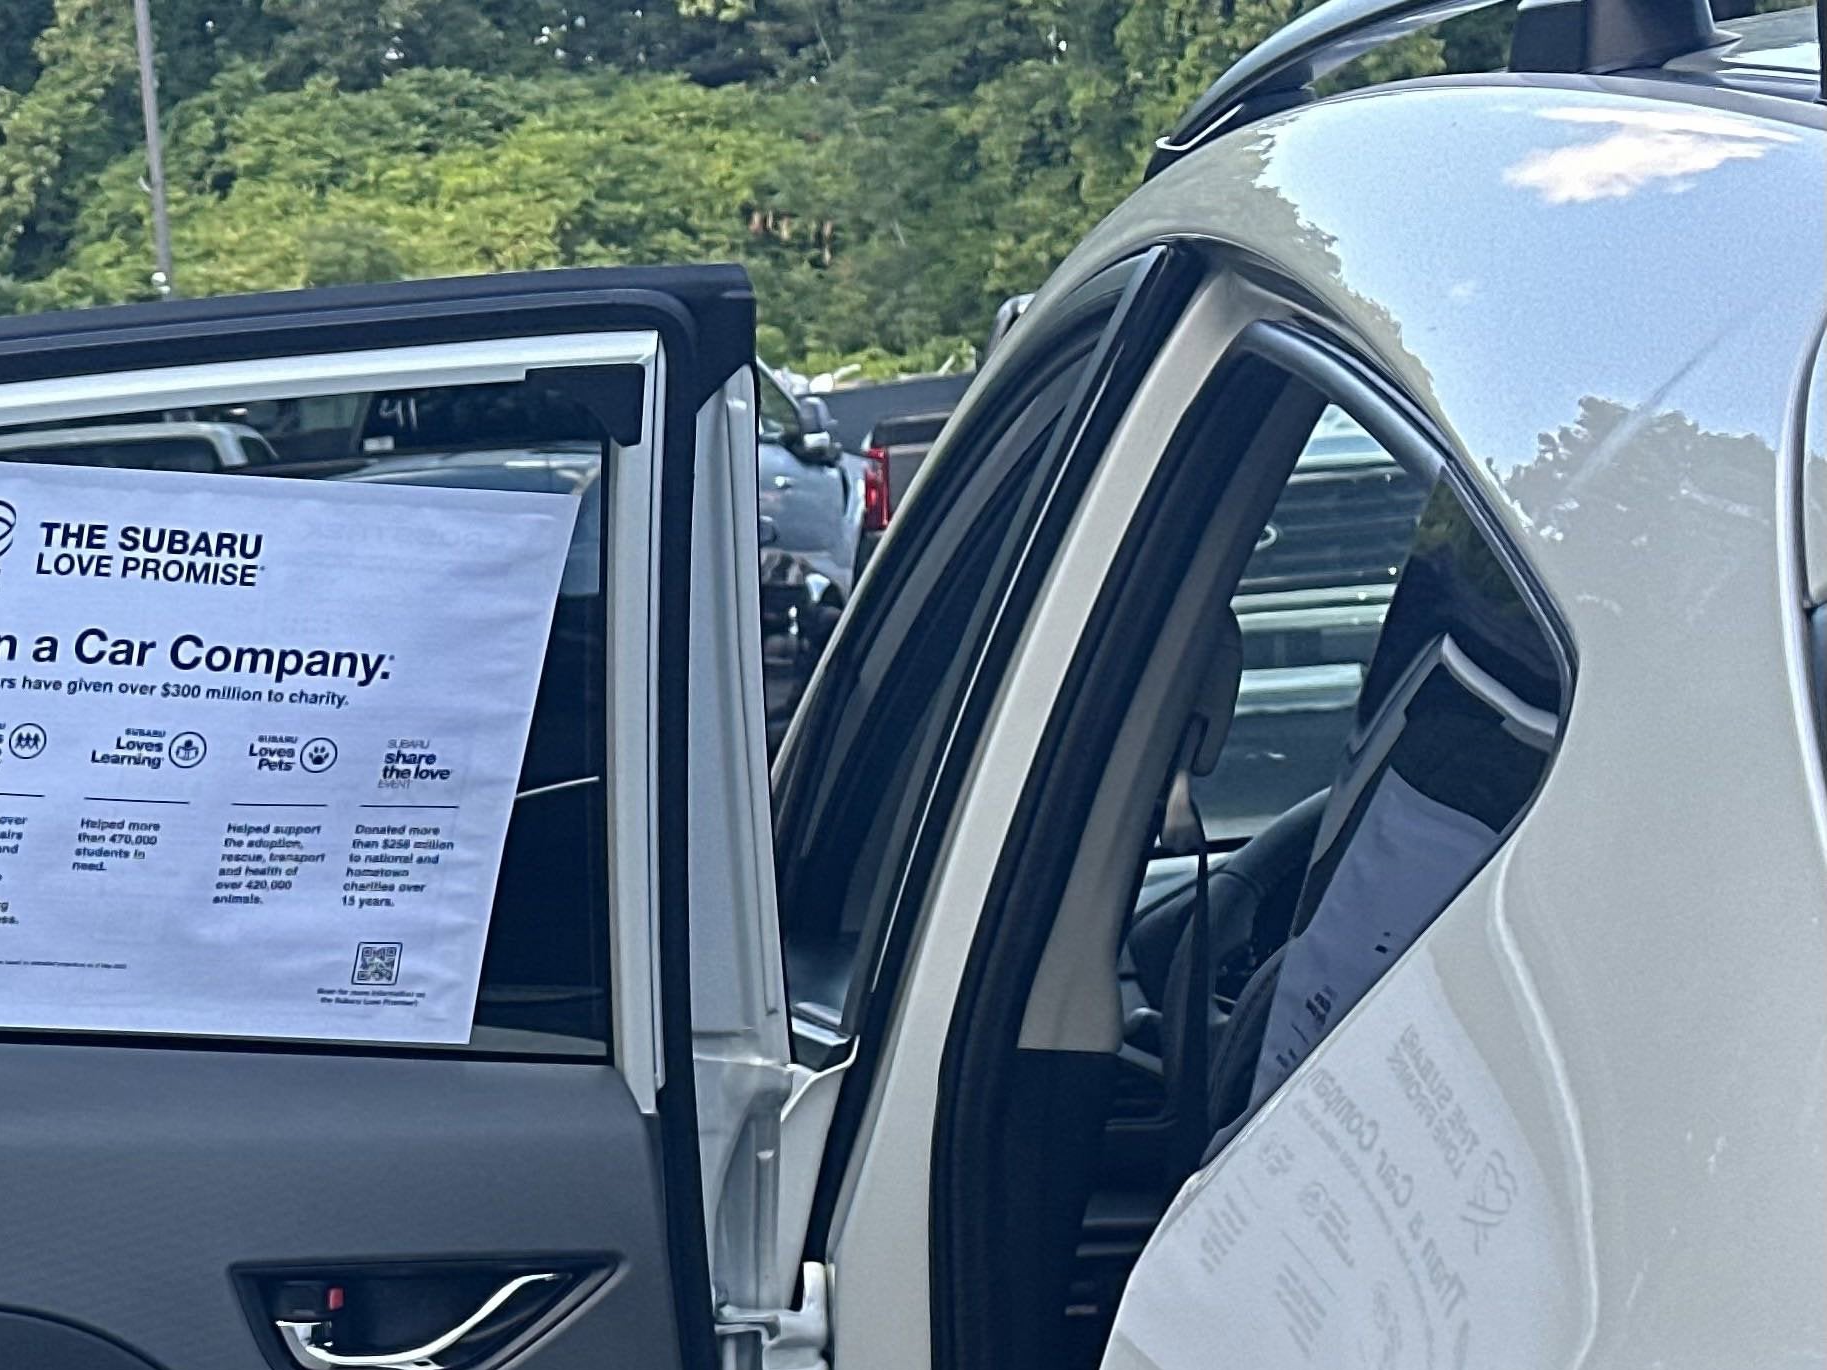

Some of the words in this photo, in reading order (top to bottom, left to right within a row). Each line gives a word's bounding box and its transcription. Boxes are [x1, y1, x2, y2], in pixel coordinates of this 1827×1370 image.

[40, 522, 108, 549] THE
[118, 526, 262, 559] SUBARU
[36, 552, 113, 577] LOVE
[121, 557, 258, 586] PROMISE
[32, 636, 58, 662] a
[75, 628, 156, 667] Car
[22, 676, 62, 690] have
[67, 678, 113, 695] given
[118, 683, 157, 696] over
[161, 682, 201, 698] $300
[206, 686, 262, 701] million
[268, 689, 284, 702] to
[289, 689, 348, 708] charity.
[116, 737, 163, 752] Loves
[249, 745, 295, 758] Loves
[91, 751, 163, 769] Learning
[258, 758, 295, 771] Pets
[384, 752, 436, 766] share
[383, 766, 411, 779] the
[413, 766, 450, 780] love
[0, 816, 27, 825] over
[81, 818, 125, 831] Helped
[227, 823, 270, 836] Helped
[273, 826, 321, 836] support
[355, 825, 406, 835] Donated
[78, 833, 105, 843] than
[224, 838, 244, 848] the
[352, 839, 379, 849] than
[75, 847, 130, 858] students
[134, 849, 145, 859] in
[349, 853, 361, 863] to
[365, 853, 413, 864] national
[416, 854, 439, 864] and
[219, 866, 242, 876] and
[245, 866, 282, 876] health
[285, 866, 298, 876] of
[216, 881, 243, 890] over
[399, 884, 426, 892] over
